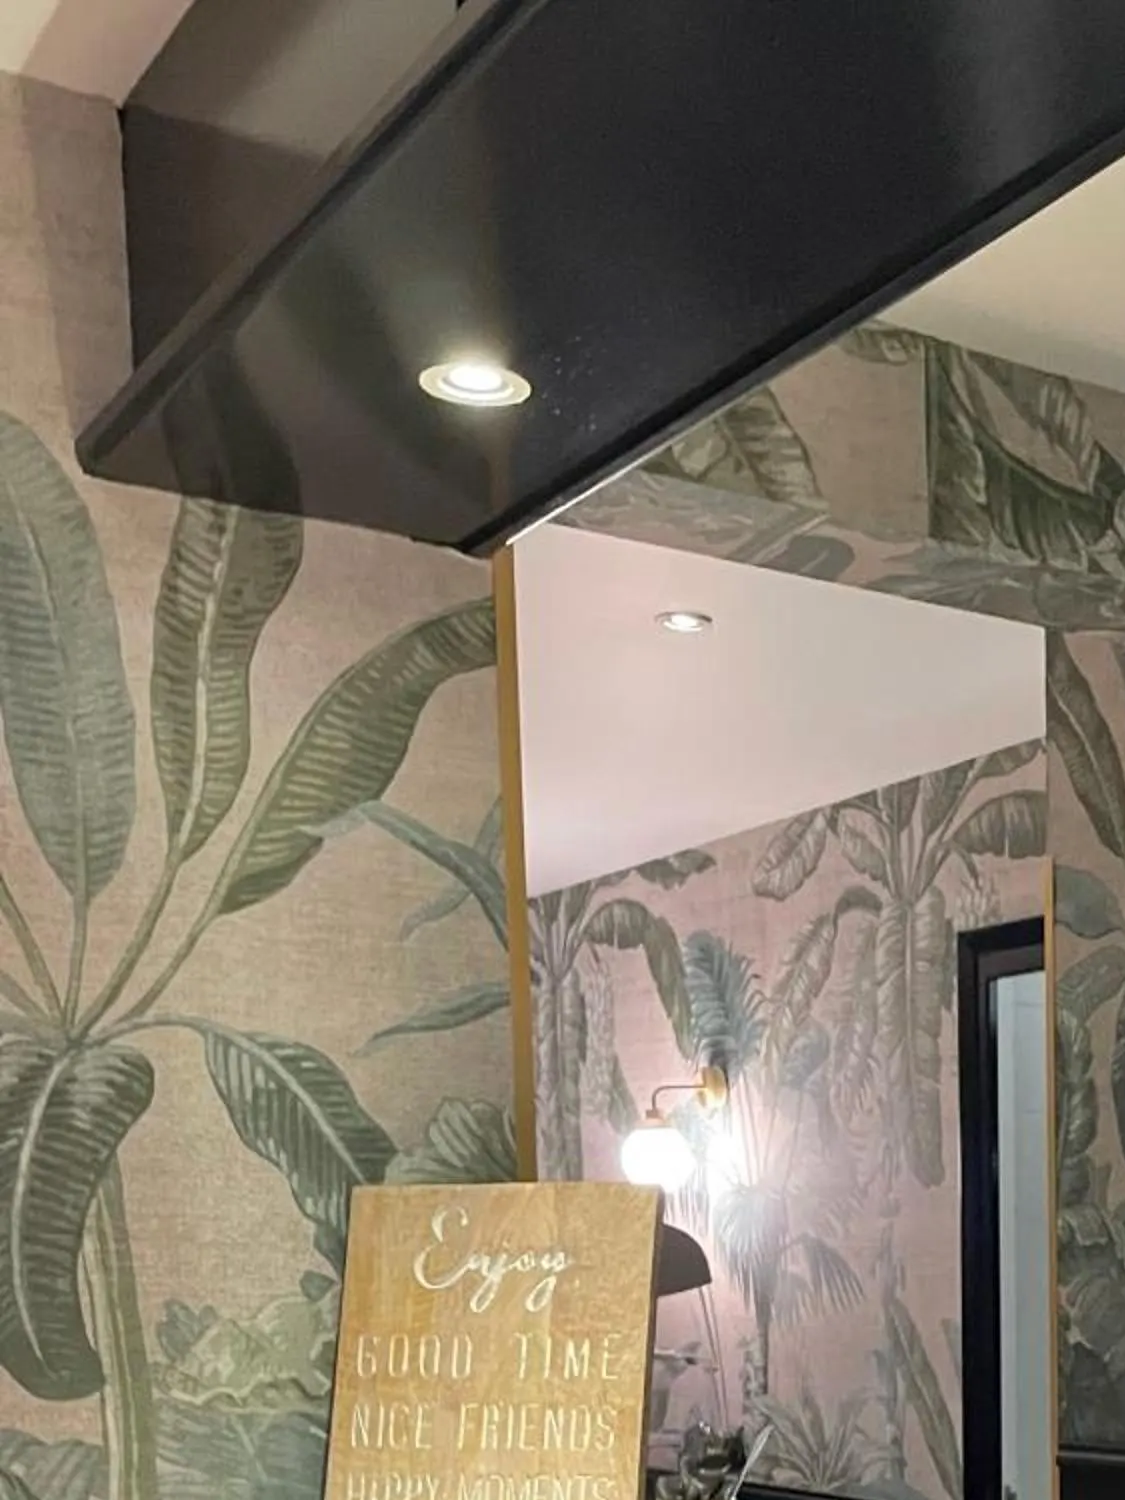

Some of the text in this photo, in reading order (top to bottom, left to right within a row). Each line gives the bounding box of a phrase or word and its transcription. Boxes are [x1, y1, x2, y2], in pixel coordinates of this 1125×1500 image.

[414, 1204, 574, 1312] Enjoy
[355, 1332, 622, 1381] GOOD TIME
[350, 1400, 618, 1451] NICE FRIENDS
